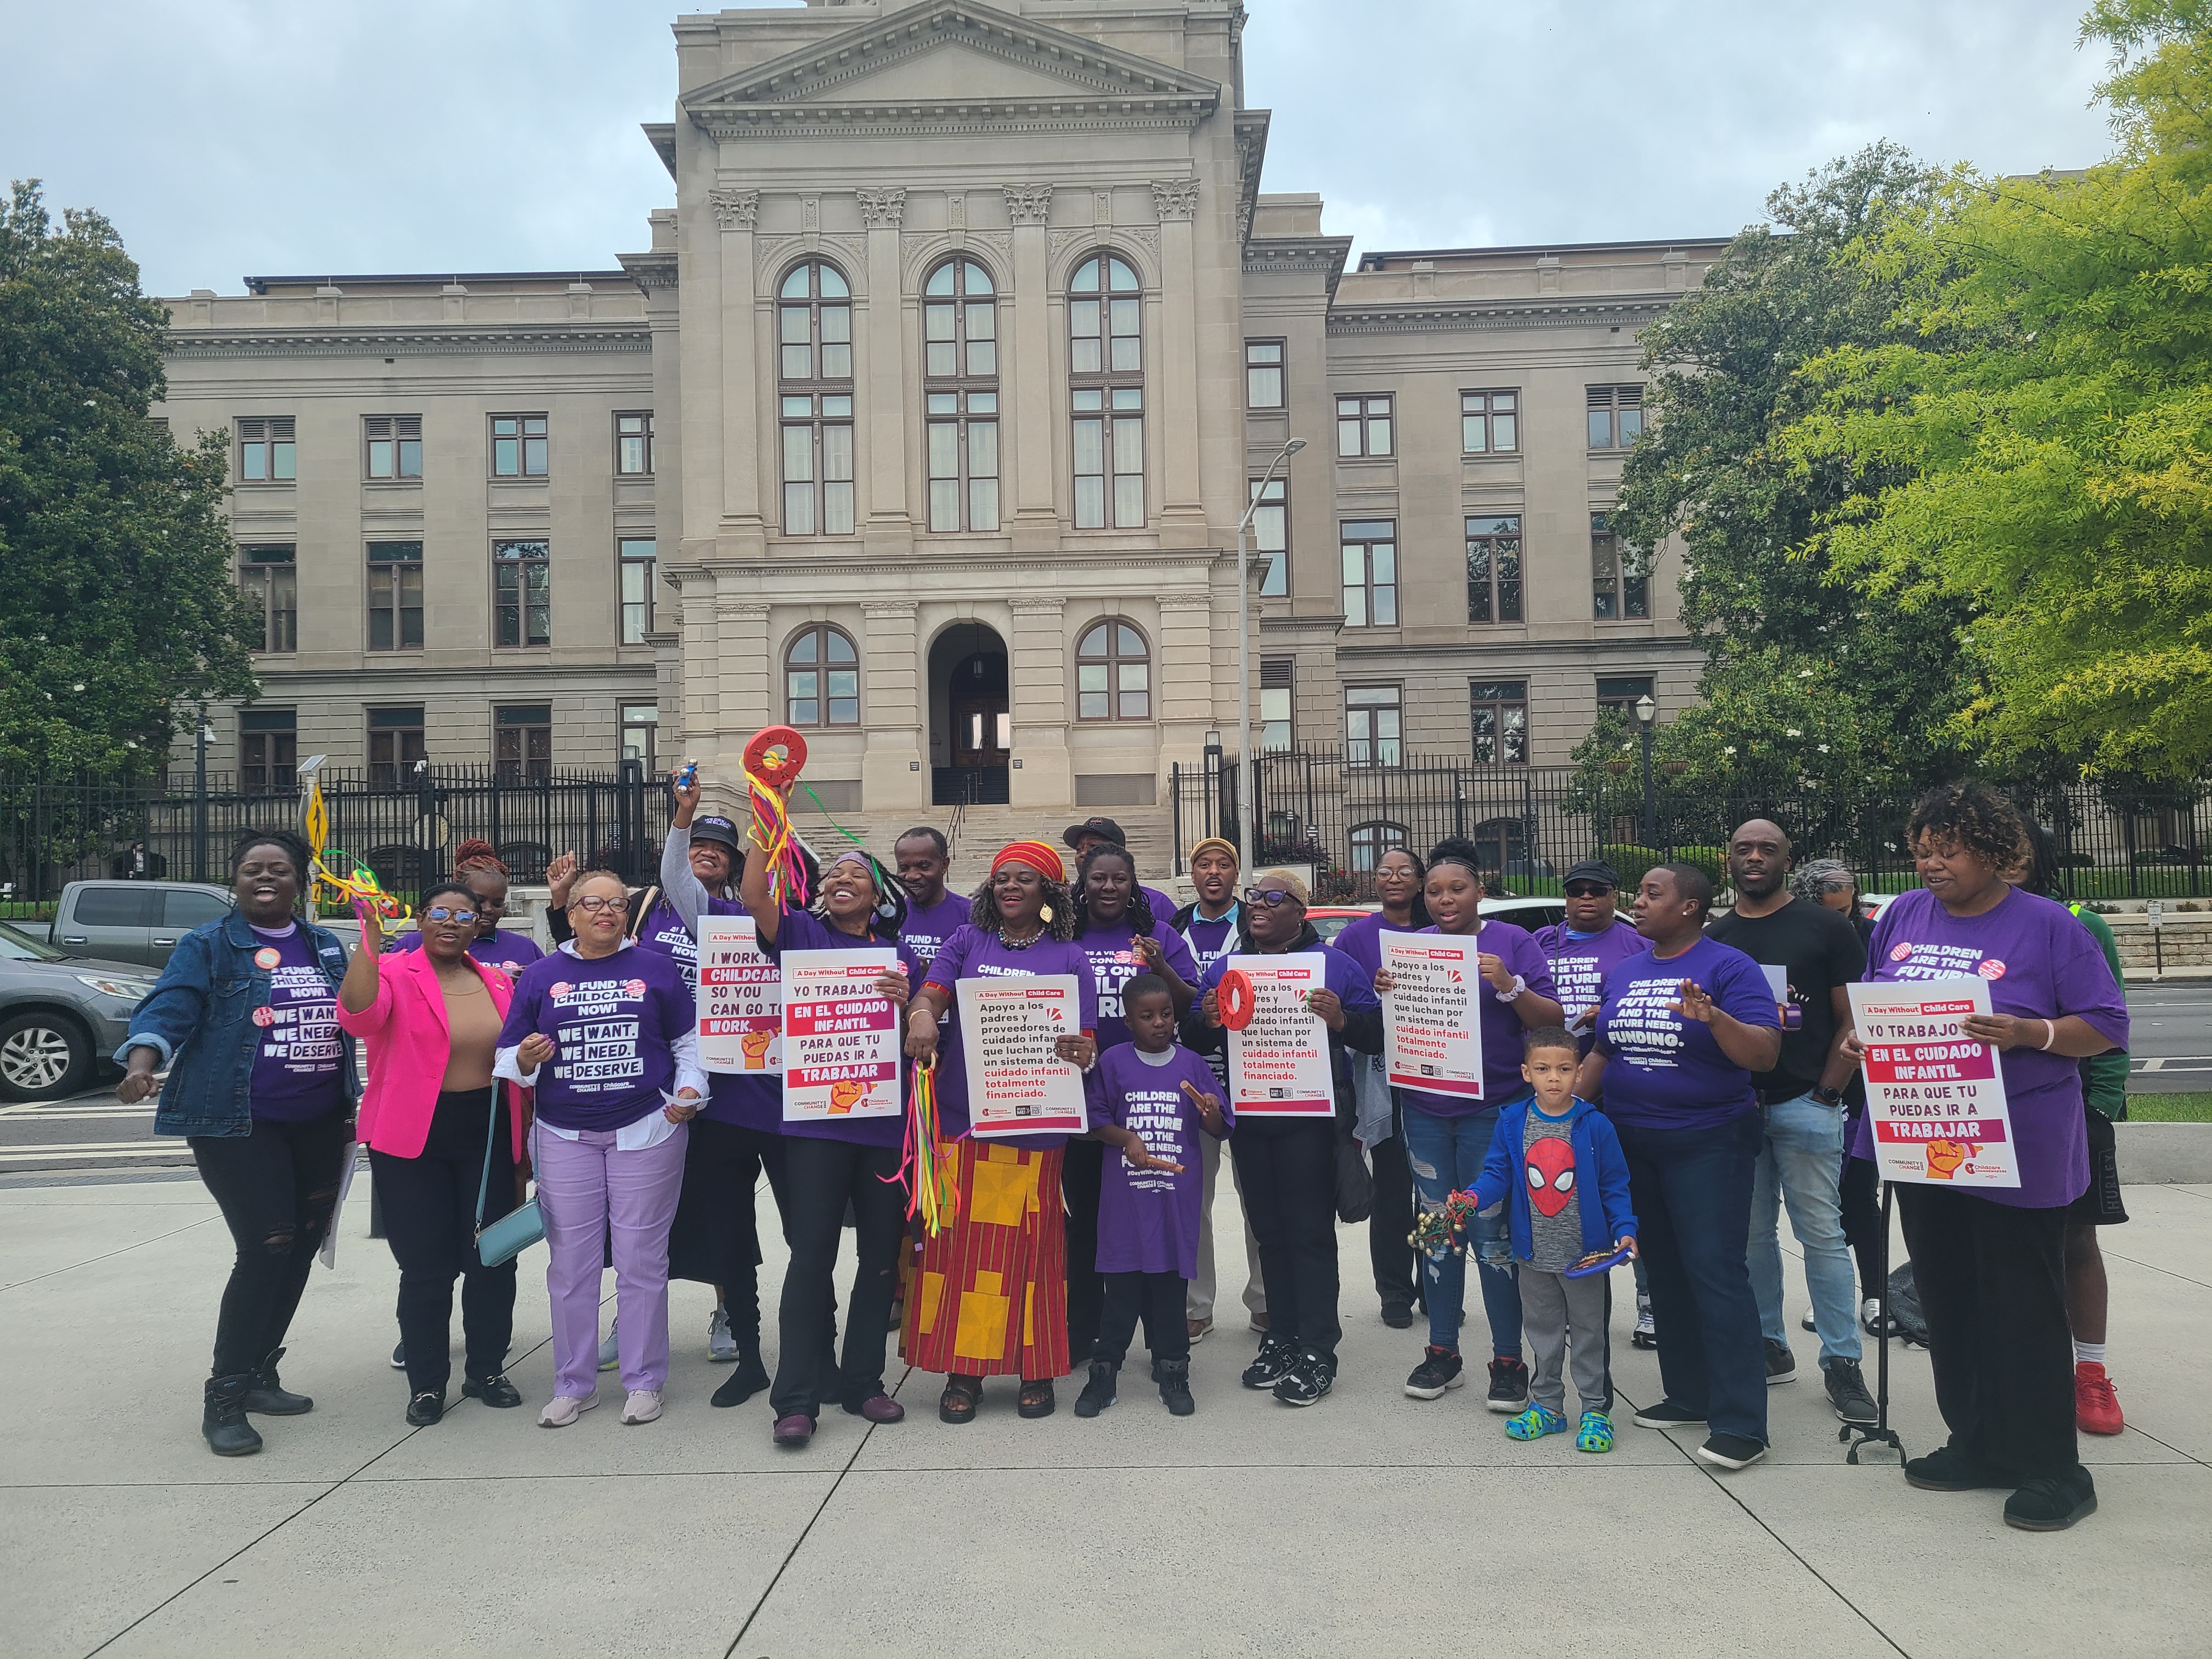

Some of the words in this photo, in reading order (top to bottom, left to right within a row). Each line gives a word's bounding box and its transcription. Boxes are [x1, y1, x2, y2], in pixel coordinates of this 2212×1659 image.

[713, 821, 729, 829] BLACK
[714, 818, 731, 828] DREAM
[905, 935, 932, 944] FUND
[712, 952, 715, 964] I
[721, 952, 760, 964] WORK
[1911, 944, 1983, 960] CHILDREN
[1391, 960, 1419, 970] Apoyo
[1430, 962, 1444, 971] los
[1907, 955, 1938, 965] ARE
[1940, 957, 1972, 969] THE
[280, 966, 315, 975] FUND
[1110, 966, 1137, 977] ON
[1392, 972, 1422, 981] padres
[579, 980, 617, 990] FUND
[1393, 983, 1451, 994] proveedores
[1454, 986, 1466, 995] de
[1628, 978, 1685, 988] CHILDREN
[290, 988, 327, 997] NOW!
[711, 986, 727, 998] SO
[735, 986, 761, 998] YOU
[794, 986, 809, 997] YO
[815, 984, 872, 996] TRABAJO
[1574, 985, 1595, 994] THE
[1393, 993, 1429, 1003] cuidado
[1431, 995, 1467, 1006] infantil
[578, 1003, 617, 1015] NOW!
[710, 1003, 740, 1015] CAN
[746, 1003, 763, 1015] GO
[794, 1006, 811, 1018] EN
[816, 1005, 831, 1016] EL
[836, 1001, 888, 1015] CUIDADO
[980, 1004, 1015, 1013] Apoyo
[1395, 1003, 1410, 1013] que
[1412, 1005, 1443, 1016] luchan
[1447, 1009, 1463, 1017] por
[1617, 1008, 1643, 1017] AND
[1645, 1009, 1671, 1019] THE
[1923, 1004, 1946, 1012] Child
[274, 1009, 297, 1023] WE
[980, 1014, 1018, 1024] padres
[1408, 1015, 1444, 1026] sistema
[1447, 1019, 1459, 1027] de
[709, 1020, 753, 1032] WORK.
[814, 1018, 871, 1032] INFANTIL
[981, 1024, 1050, 1035] proveedores
[1053, 1024, 1065, 1032] de
[1609, 1019, 1644, 1029] FUTURE
[1645, 1019, 1682, 1031] NEEDS
[1867, 1025, 1883, 1037] YO
[1888, 1023, 1958, 1037] TRABAJO
[273, 1028, 298, 1041] WE
[558, 1028, 582, 1042] WE
[588, 1024, 635, 1039] WANT.
[1242, 1029, 1258, 1038] que
[1261, 1027, 1292, 1036] luchan
[1295, 1029, 1311, 1037] por
[1396, 1025, 1431, 1036] cuidado
[1434, 1028, 1469, 1040] infantil
[1607, 1030, 1685, 1047] FUNDING.
[800, 1038, 833, 1049] PARA
[838, 1036, 860, 1047] QUE
[865, 1034, 880, 1045] TU
[982, 1036, 1026, 1045] cuidado
[1256, 1039, 1293, 1047] sistema
[1296, 1039, 1307, 1047] de
[1397, 1035, 1447, 1048] totalmente
[264, 1044, 288, 1057] WE
[561, 1046, 583, 1060] WE
[588, 1045, 631, 1058] NEED.
[804, 1051, 849, 1064] PUEDAS
[854, 1049, 865, 1060] IR
[870, 1049, 878, 1059] A
[983, 1048, 1003, 1056] que
[1006, 1046, 1043, 1054] luchan
[1242, 1049, 1279, 1058] cuidado
[1282, 1049, 1317, 1058] infantil
[1397, 1045, 1447, 1060] financiado.
[1871, 1048, 1889, 1062] EN
[1893, 1048, 1910, 1061] EL
[1915, 1043, 1982, 1059] CUIDADO
[1001, 1057, 1043, 1065] sistema
[1243, 1060, 1296, 1069] totalmente
[554, 1066, 572, 1079] WE
[576, 1062, 641, 1077] DESERVE.
[802, 1064, 878, 1082] TRABAJAR
[985, 1068, 1028, 1077] cuidado
[1031, 1067, 1070, 1076] infantil
[1244, 1071, 1297, 1080] financiado.
[1894, 1064, 1961, 1080] INFANTIL
[985, 1079, 1046, 1088] totalmente
[986, 1089, 1047, 1099] financiado.
[1125, 1091, 1180, 1102] CHILDREN
[1883, 1087, 1920, 1099] PARA
[1924, 1086, 1952, 1098] QUE
[1957, 1085, 1977, 1098] TU
[1130, 1104, 1151, 1114] ARE
[1153, 1103, 1176, 1114] THE
[1889, 1104, 1941, 1116] PUEDAS
[1947, 1104, 1960, 1116] IR
[1968, 1103, 1978, 1115] A
[1126, 1116, 1182, 1131] FUTURE
[1889, 1121, 1980, 1138] TRABAJAR
[1155, 1131, 1174, 1142] THE
[1156, 1143, 1182, 1153] NEEDS
[2106, 1155, 2119, 1209] HURLEY
